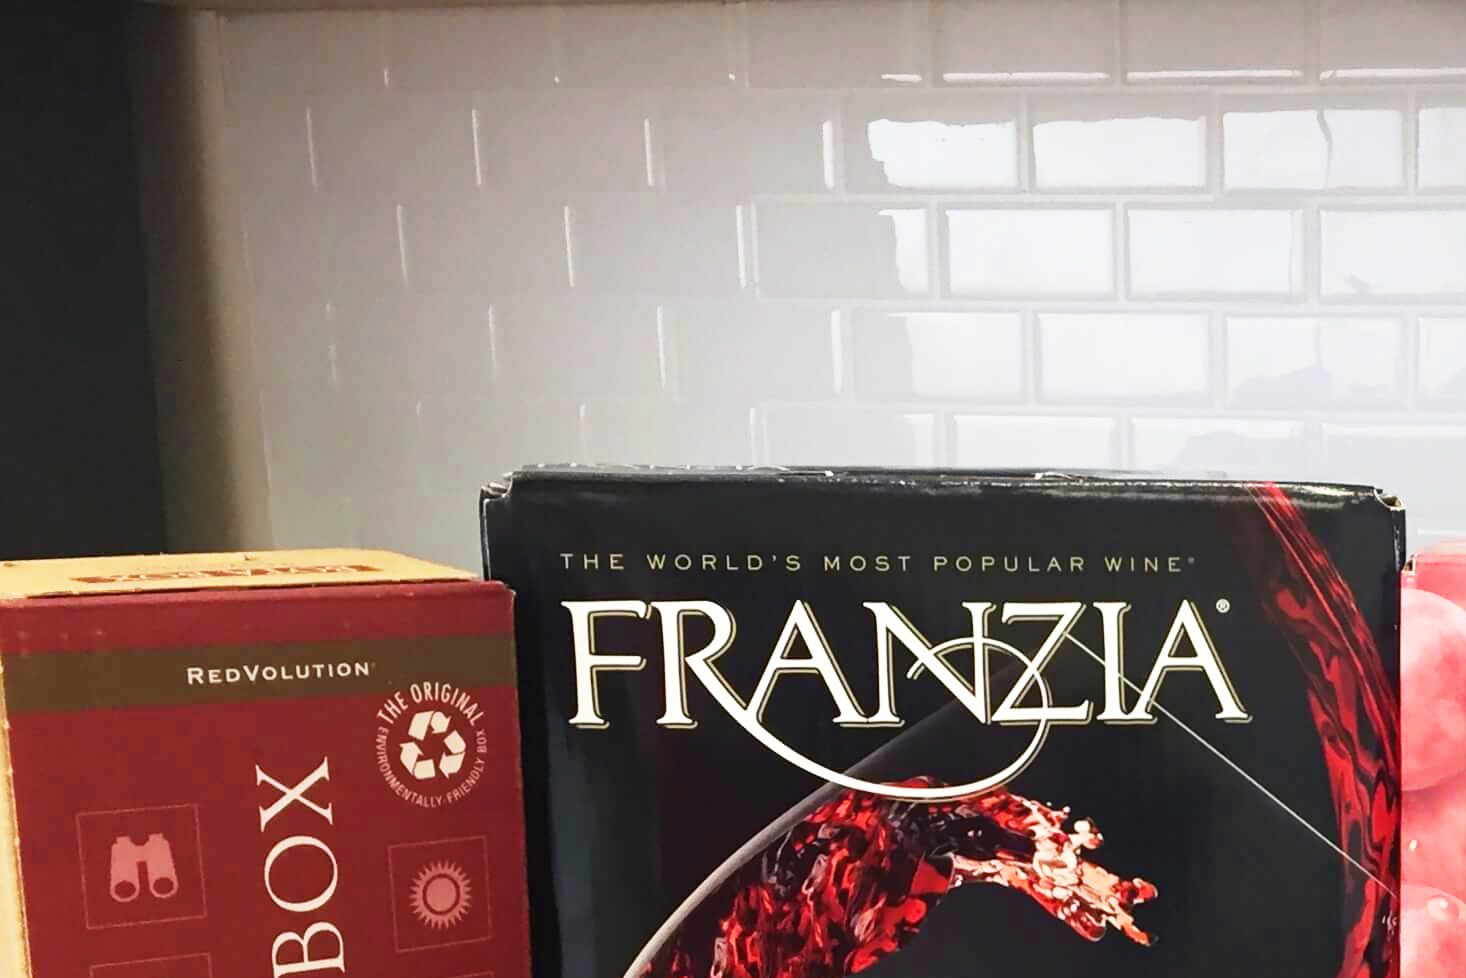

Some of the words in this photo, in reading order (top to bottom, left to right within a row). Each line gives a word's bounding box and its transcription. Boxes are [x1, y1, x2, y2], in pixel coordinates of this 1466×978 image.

[560, 553, 625, 570] THE
[824, 555, 911, 572] MOST
[933, 556, 1085, 572] POPULAR
[376, 691, 409, 725] THE
[410, 681, 485, 726] ORIGINAL
[375, 726, 443, 808] ENVIRONMENTALLY
[446, 758, 486, 804] FRIENDLY
[476, 728, 488, 753] BOX
